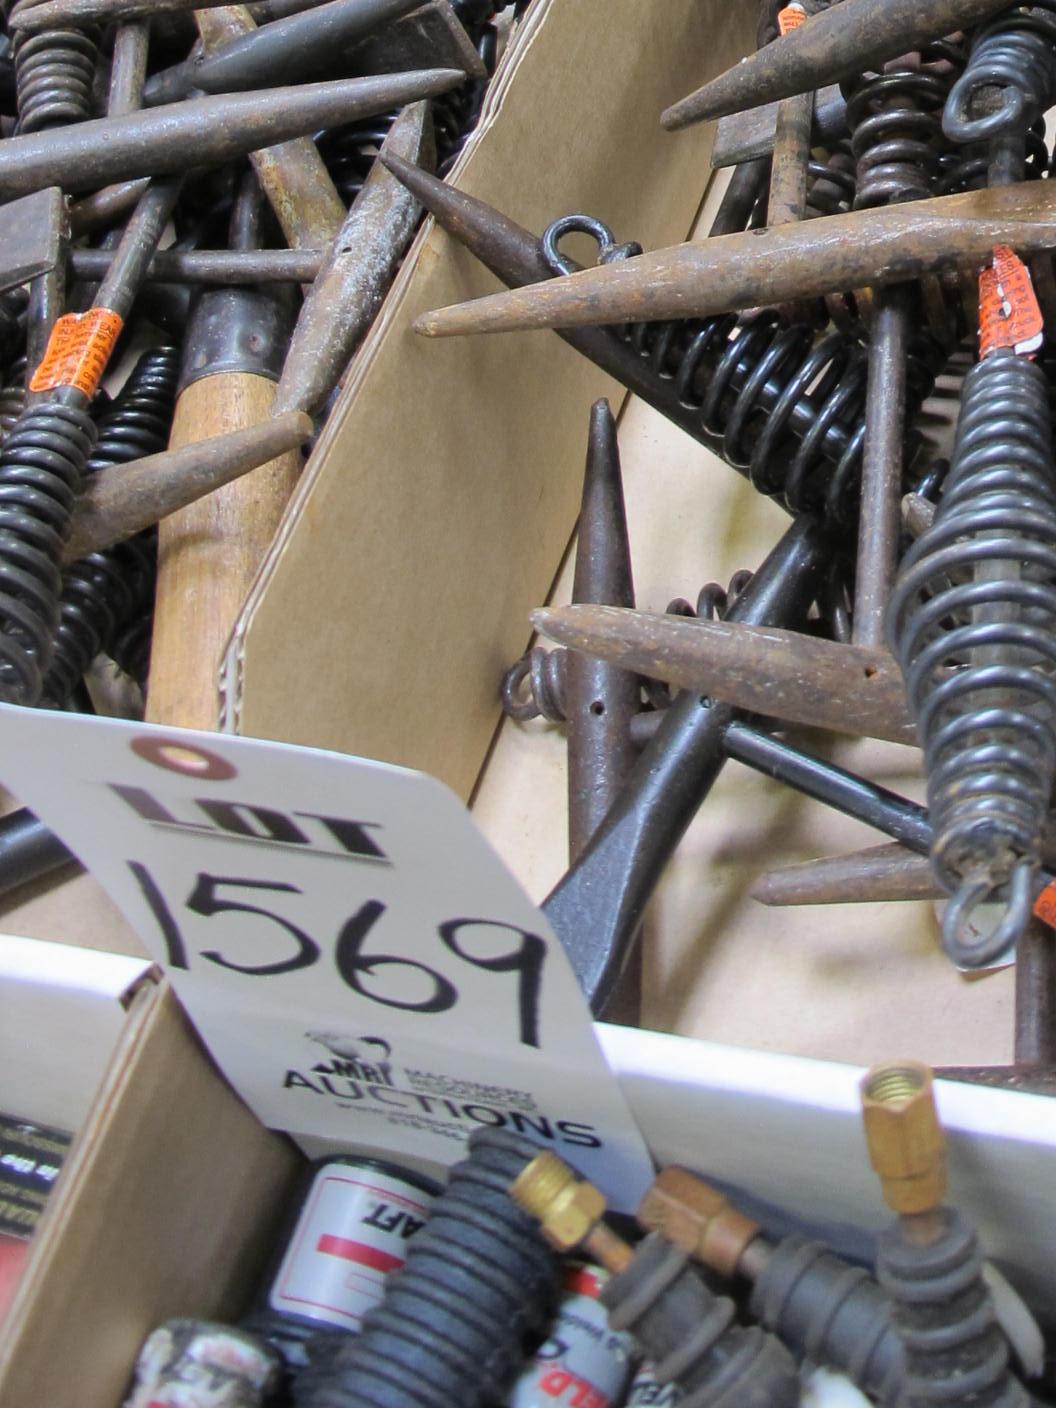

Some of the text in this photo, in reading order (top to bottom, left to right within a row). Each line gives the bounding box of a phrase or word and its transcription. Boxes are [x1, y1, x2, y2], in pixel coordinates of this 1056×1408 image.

[107, 782, 388, 859] LOT
[126, 859, 547, 1049] 1569
[282, 1069, 603, 1149] AUCTIONS
[332, 1058, 394, 1086] MRI
